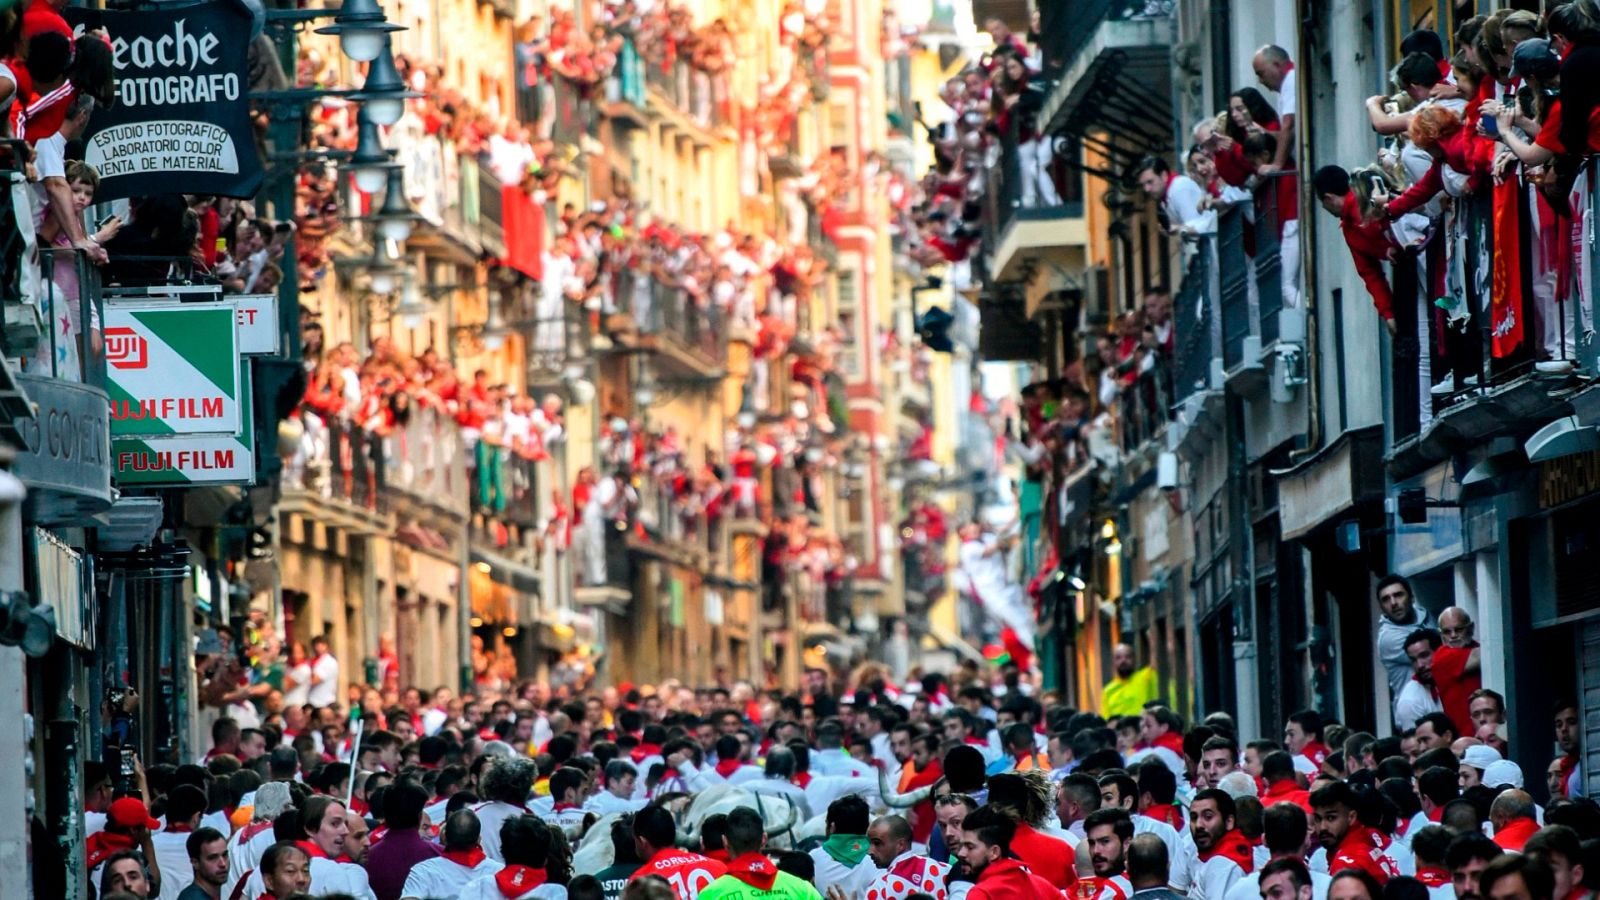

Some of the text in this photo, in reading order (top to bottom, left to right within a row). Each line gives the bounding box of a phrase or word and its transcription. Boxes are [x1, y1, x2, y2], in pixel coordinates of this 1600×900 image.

[94, 123, 228, 148] ESTUDIO FOTOGRAFICO
[103, 139, 222, 161] LABORATORIO COLOR
[95, 156, 224, 176] VENTA DE MATERIAL
[654, 854, 707, 870] CORELLA
[667, 866, 715, 900] 10
